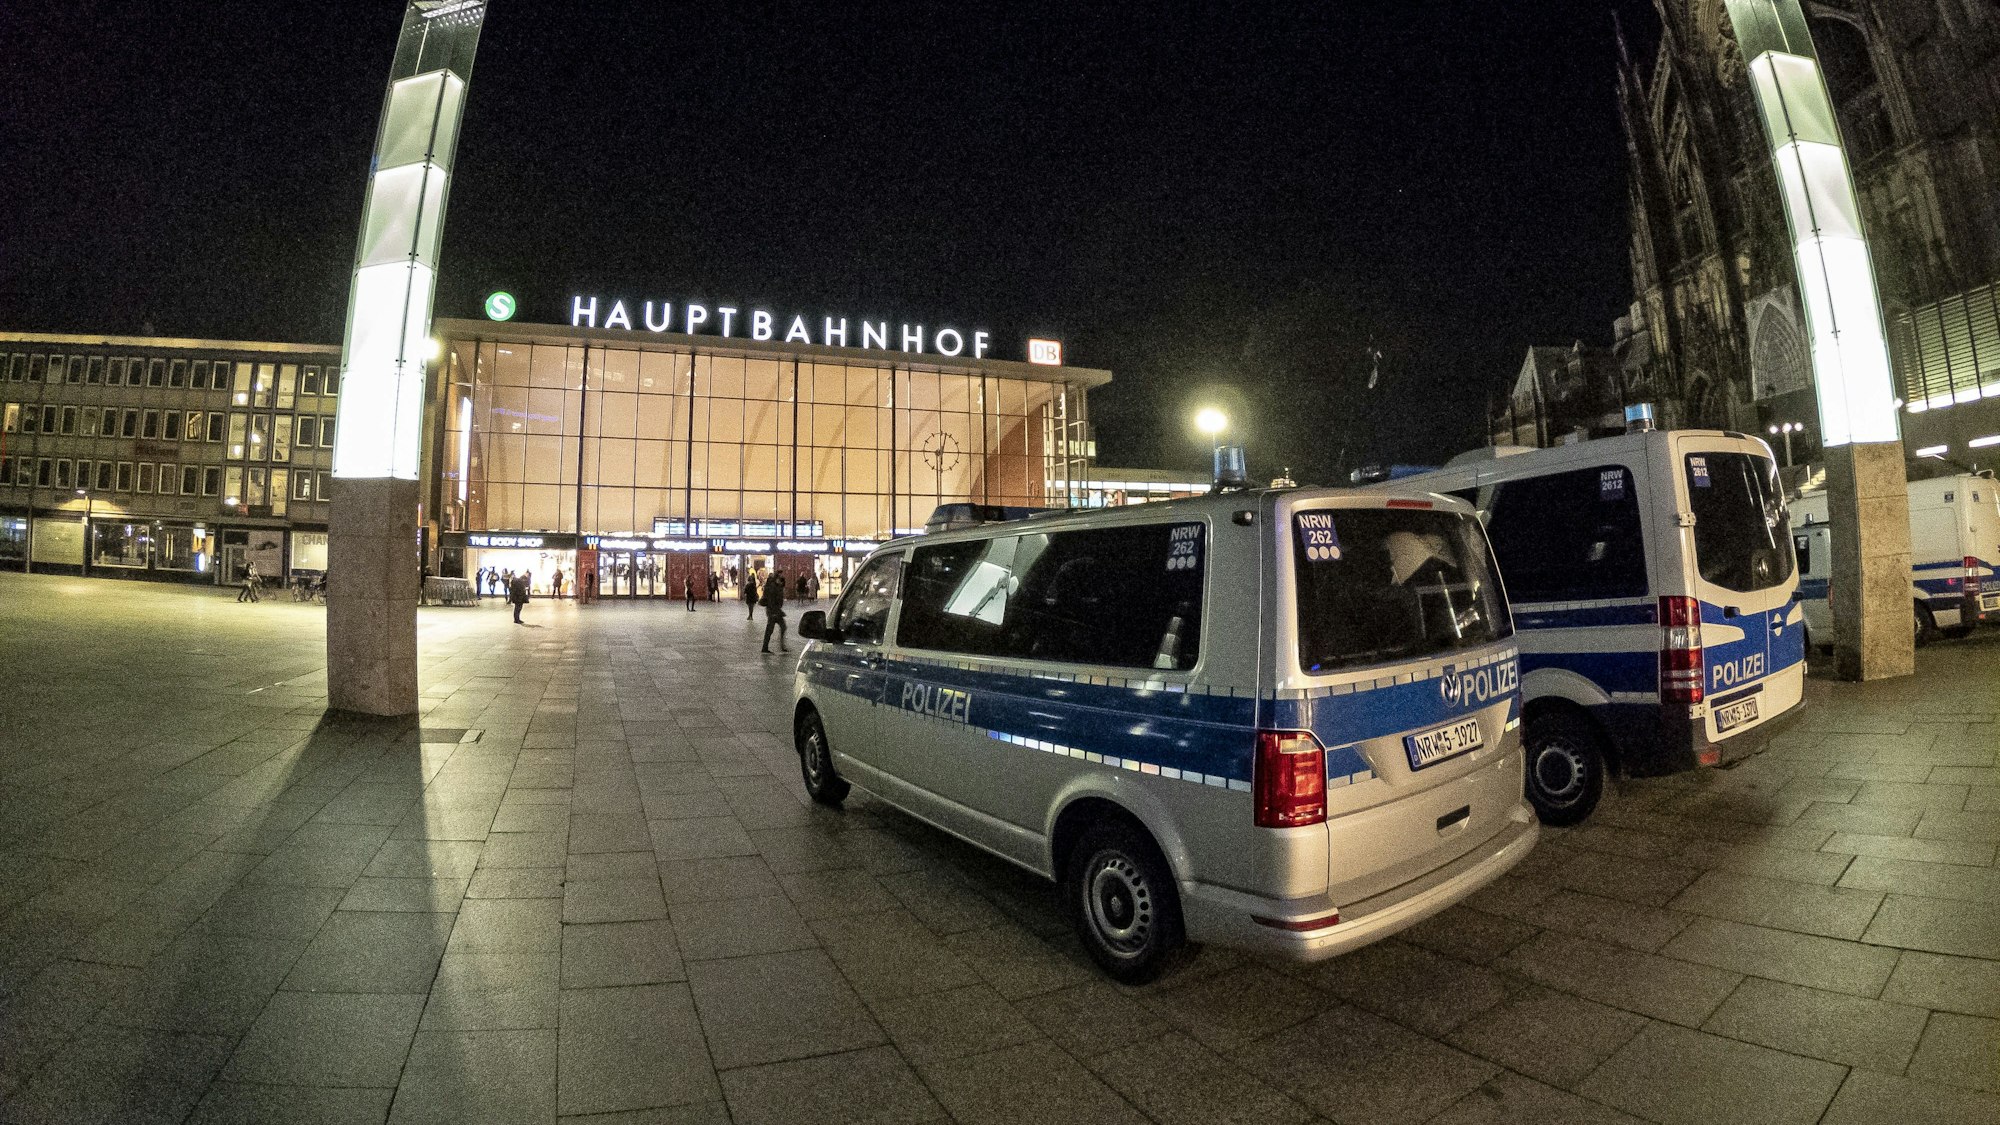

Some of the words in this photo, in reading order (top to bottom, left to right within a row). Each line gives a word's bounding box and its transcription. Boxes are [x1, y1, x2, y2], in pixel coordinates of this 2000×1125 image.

[488, 294, 511, 319] S
[572, 295, 990, 360] HAUPTBAHNHOF
[1033, 343, 1057, 361] DB
[1689, 457, 1706, 467] NRW
[1601, 469, 1624, 481] NRW
[1693, 467, 1709, 477] 2612
[1602, 480, 1623, 491] 2612
[1298, 514, 1333, 529] NRW
[1170, 525, 1201, 541] NRW
[1308, 530, 1333, 545] 262
[470, 536, 489, 546] THE
[489, 536, 517, 547] BODY
[517, 537, 544, 548] SHOP
[1173, 541, 1195, 555] 262
[1712, 652, 1765, 690] POLIZEI
[1462, 659, 1519, 707] POLIZEI
[901, 681, 972, 724] POLIZEI
[1415, 730, 1440, 761] NRW
[1442, 721, 1479, 751] 5-1927
